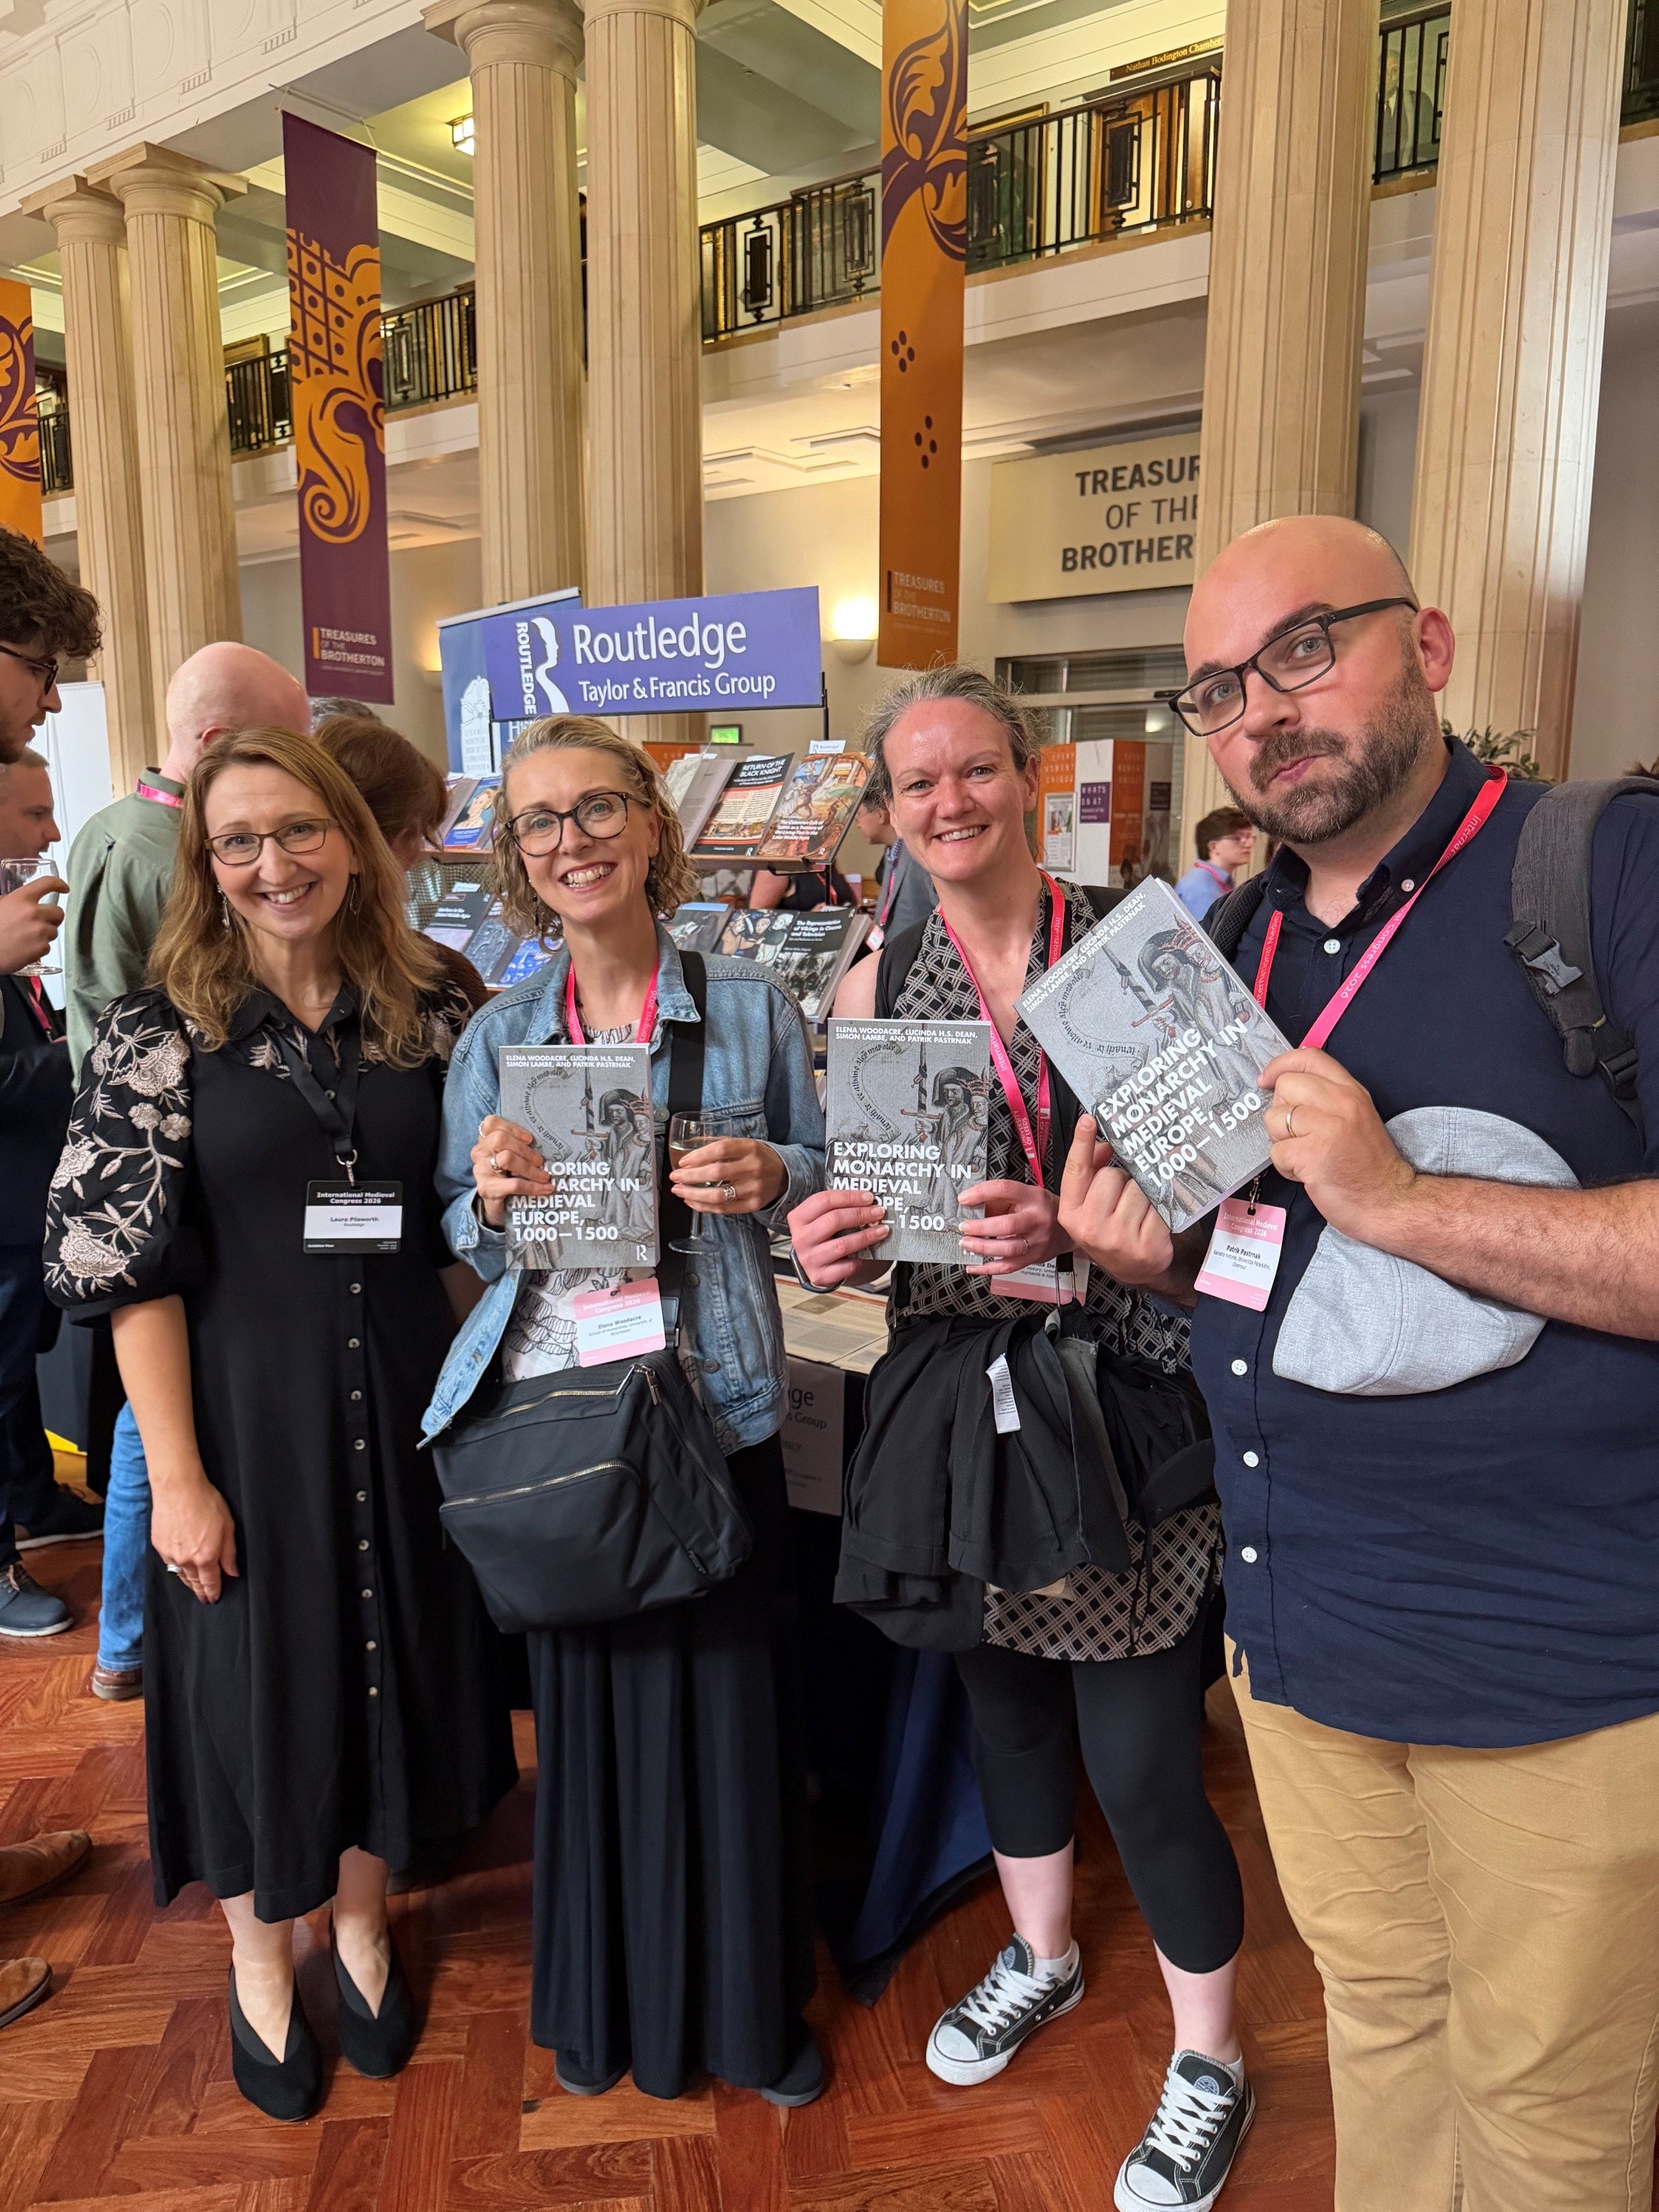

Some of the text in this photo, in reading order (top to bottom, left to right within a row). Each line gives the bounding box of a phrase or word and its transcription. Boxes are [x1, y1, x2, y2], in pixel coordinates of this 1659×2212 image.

[1126, 60, 1151, 73] Nathan
[1152, 48, 1188, 64] Bodington
[1075, 455, 1200, 496] TREASUR
[1106, 501, 1142, 530] OF
[1062, 534, 1194, 573] BROTHER
[320, 627, 377, 645] TREASURES
[573, 612, 747, 669] Routledge
[321, 650, 385, 667] BROTHERTON
[516, 622, 538, 715] ROUTLEDGE
[579, 672, 776, 708] Taylor & Francis Group
[759, 766, 783, 775] KNIGHT
[1446, 815, 1481, 860] Internatio
[1267, 913, 1279, 945] Medie
[1022, 892, 1146, 1009] ELENA WOODACRE, LUCINDA H.S. DEAN,
[1026, 902, 1146, 1015] SIMON LAMBE, AND PATRIK PASTRNAK
[1341, 924, 1395, 999] Congress 2026
[640, 1012, 652, 1042] Congress
[859, 1027, 903, 1036] WOODACRE,
[905, 1029, 937, 1037] LUCINDA
[862, 1034, 888, 1042] LAMBE,
[990, 1029, 1008, 1072] Internatio
[1097, 1028, 1200, 1121] EXPLORING
[1111, 1017, 1249, 1139] MONARCHY IN
[1013, 1111, 1027, 1146] UNIVERSITY
[1122, 1077, 1213, 1156] MEDIEVAL
[1022, 1118, 1032, 1146] OF LEEDS
[1134, 1108, 1214, 1173] EUROPE,
[833, 1142, 940, 1161] EXPLORING
[544, 1162, 610, 1176] LORING
[833, 1159, 972, 1179] MONARCHY IN
[551, 1178, 640, 1192] ARCHY IN
[833, 1176, 922, 1195] MEDIEVAL
[512, 1194, 596, 1209] MEDIEVAL
[874, 1196, 910, 1214] OPE,
[512, 1211, 585, 1226] EUROPE,
[1224, 1212, 1279, 1231] International Medieval
[1231, 1222, 1267, 1238] Congress 2026
[1226, 1245, 1261, 1260] Patrik Pastrnak
[582, 1297, 623, 1311] International
[594, 1298, 641, 1314] Congress 2026
[598, 1315, 642, 1330] Elena Woodacre
